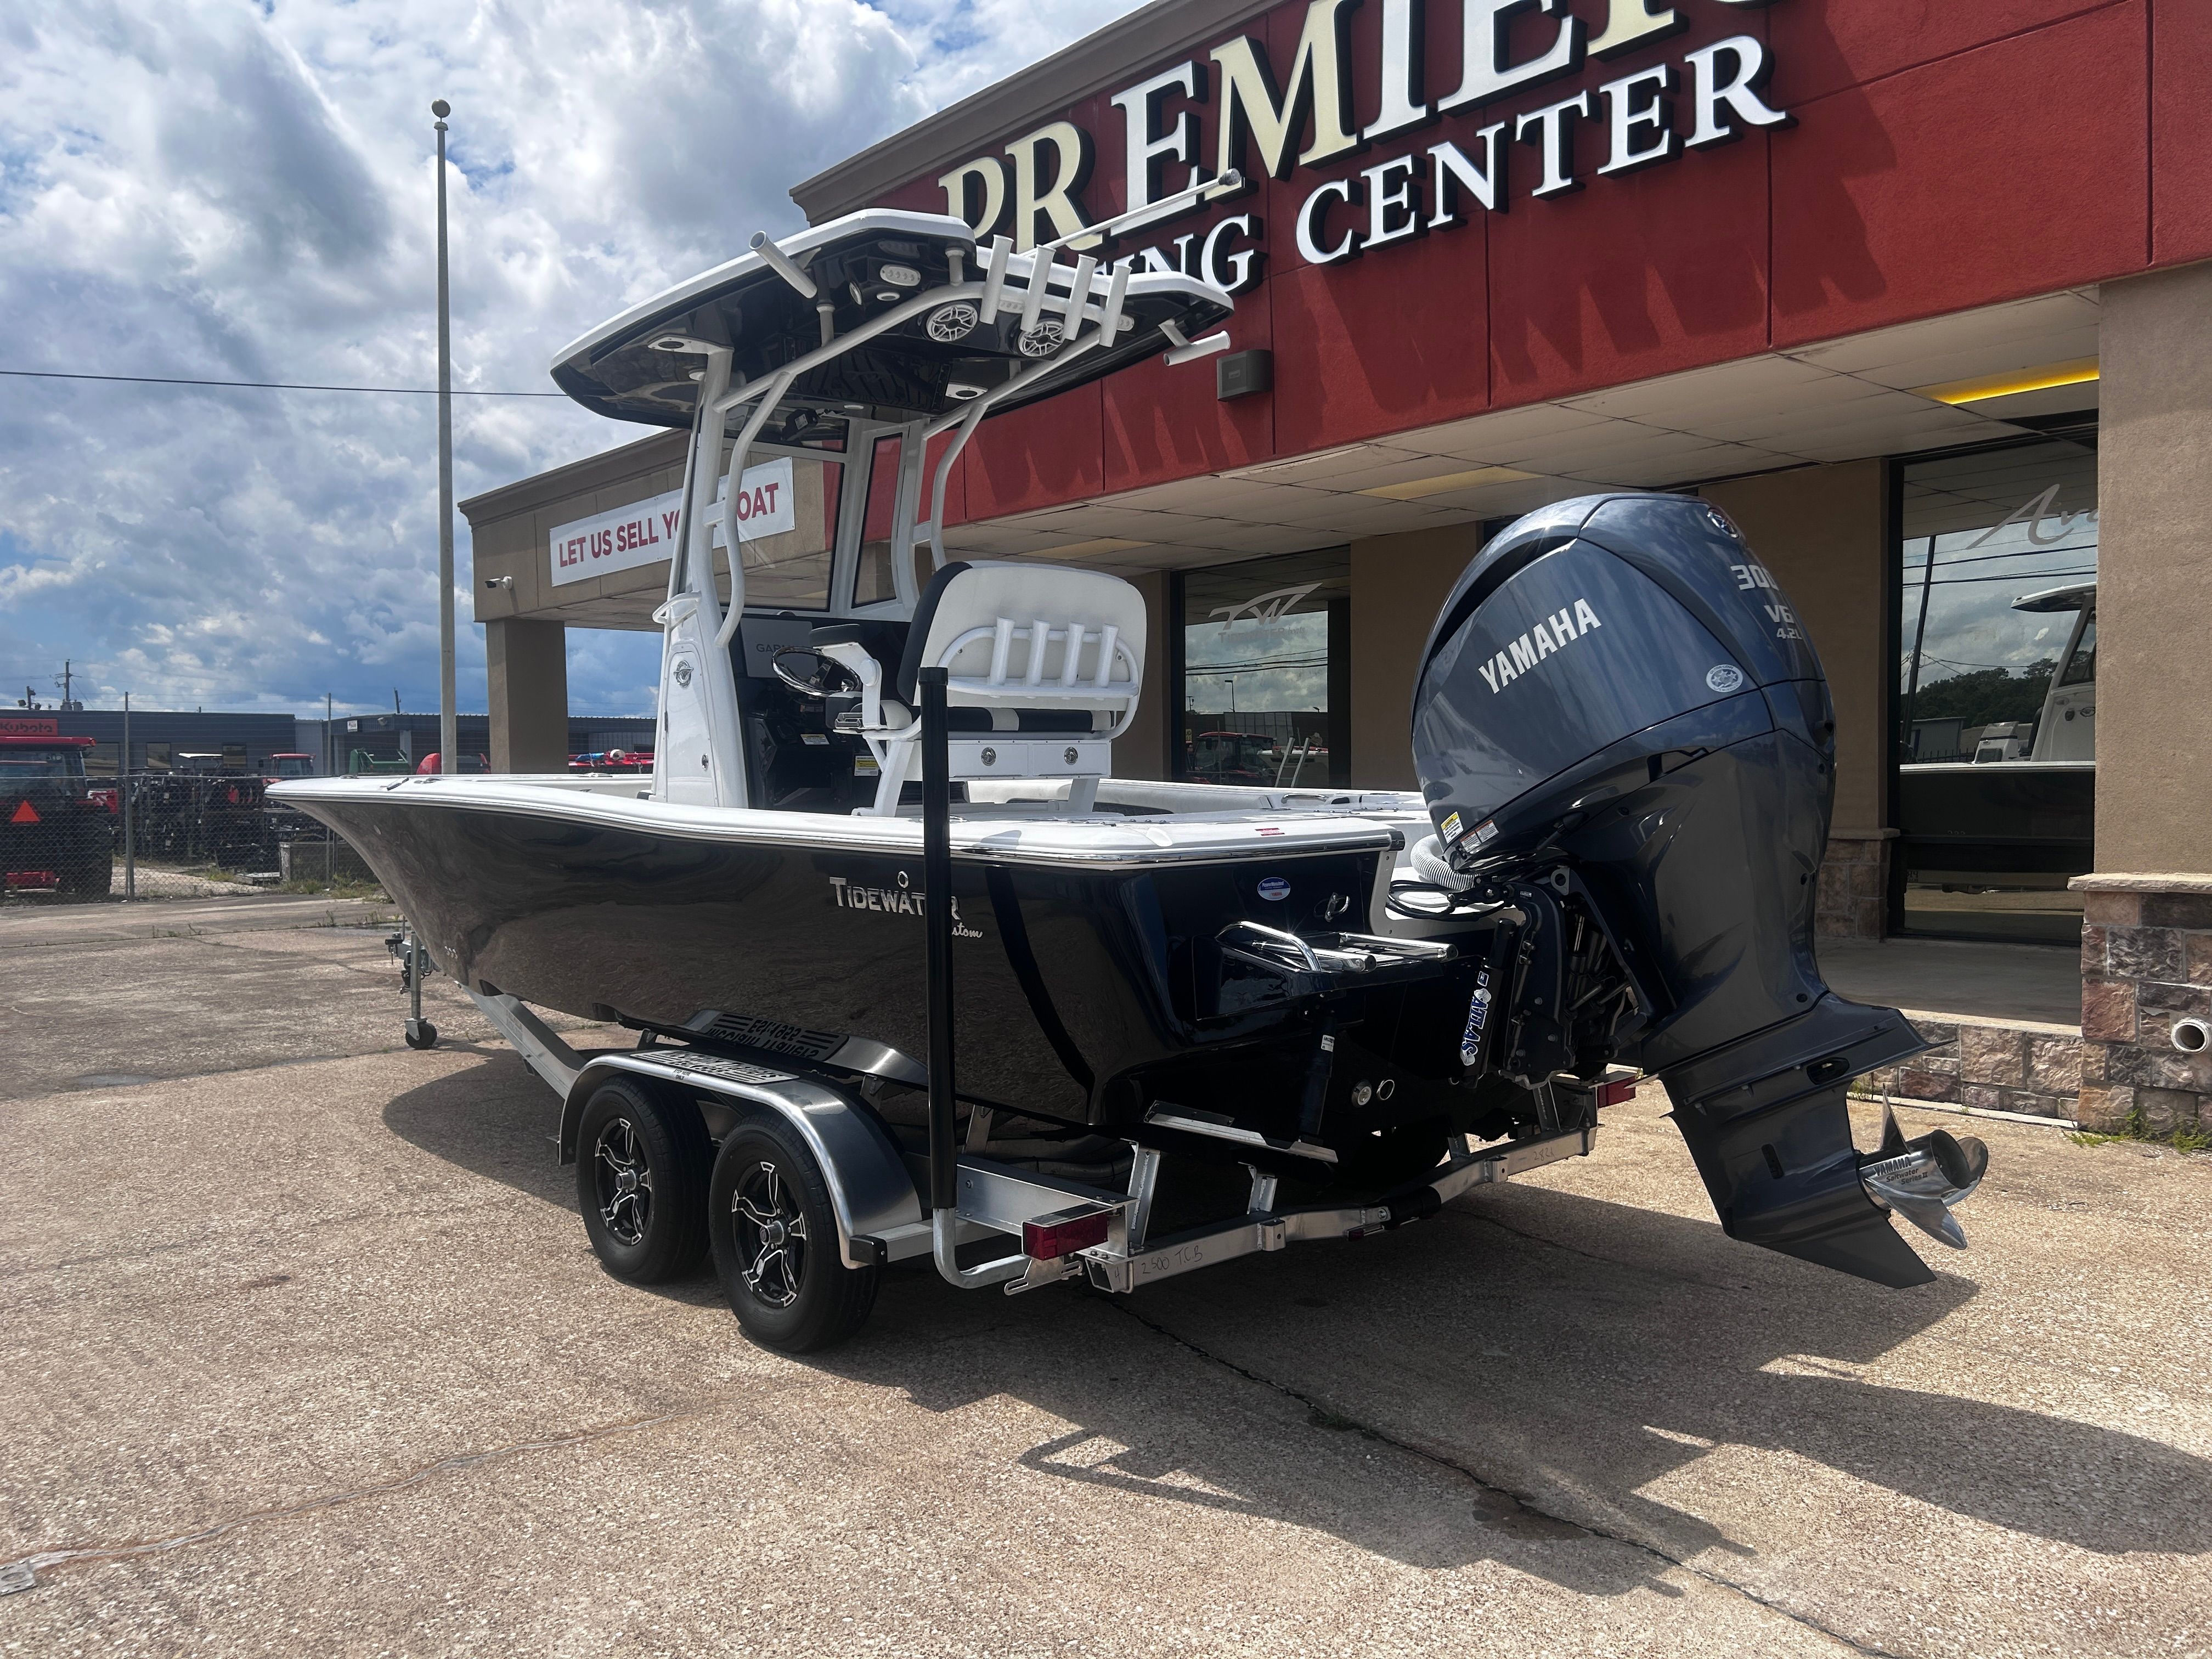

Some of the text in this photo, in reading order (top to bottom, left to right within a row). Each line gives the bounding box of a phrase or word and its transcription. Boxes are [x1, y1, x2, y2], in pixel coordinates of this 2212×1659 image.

[938, 0, 1769, 255] PREMIE
[1295, 34, 1787, 265] CENTER
[558, 537, 586, 567] LET
[590, 529, 613, 559] US
[617, 517, 659, 552] SELL
[737, 482, 779, 521] OAT
[1730, 564, 1780, 591] 300
[1764, 605, 1795, 624] V6
[1776, 628, 1803, 640] 4.2L
[1479, 597, 1602, 695] YAMAHA
[1, 723, 53, 733] Kubota
[829, 876, 962, 921] TIDEWATR
[952, 922, 983, 938] stom
[1461, 995, 1488, 1057] ATLAS
[1874, 1156, 1912, 1176] YAMAHA
[1886, 1168, 1919, 1182] Saltwater
[1141, 1257, 1170, 1274] 2500
